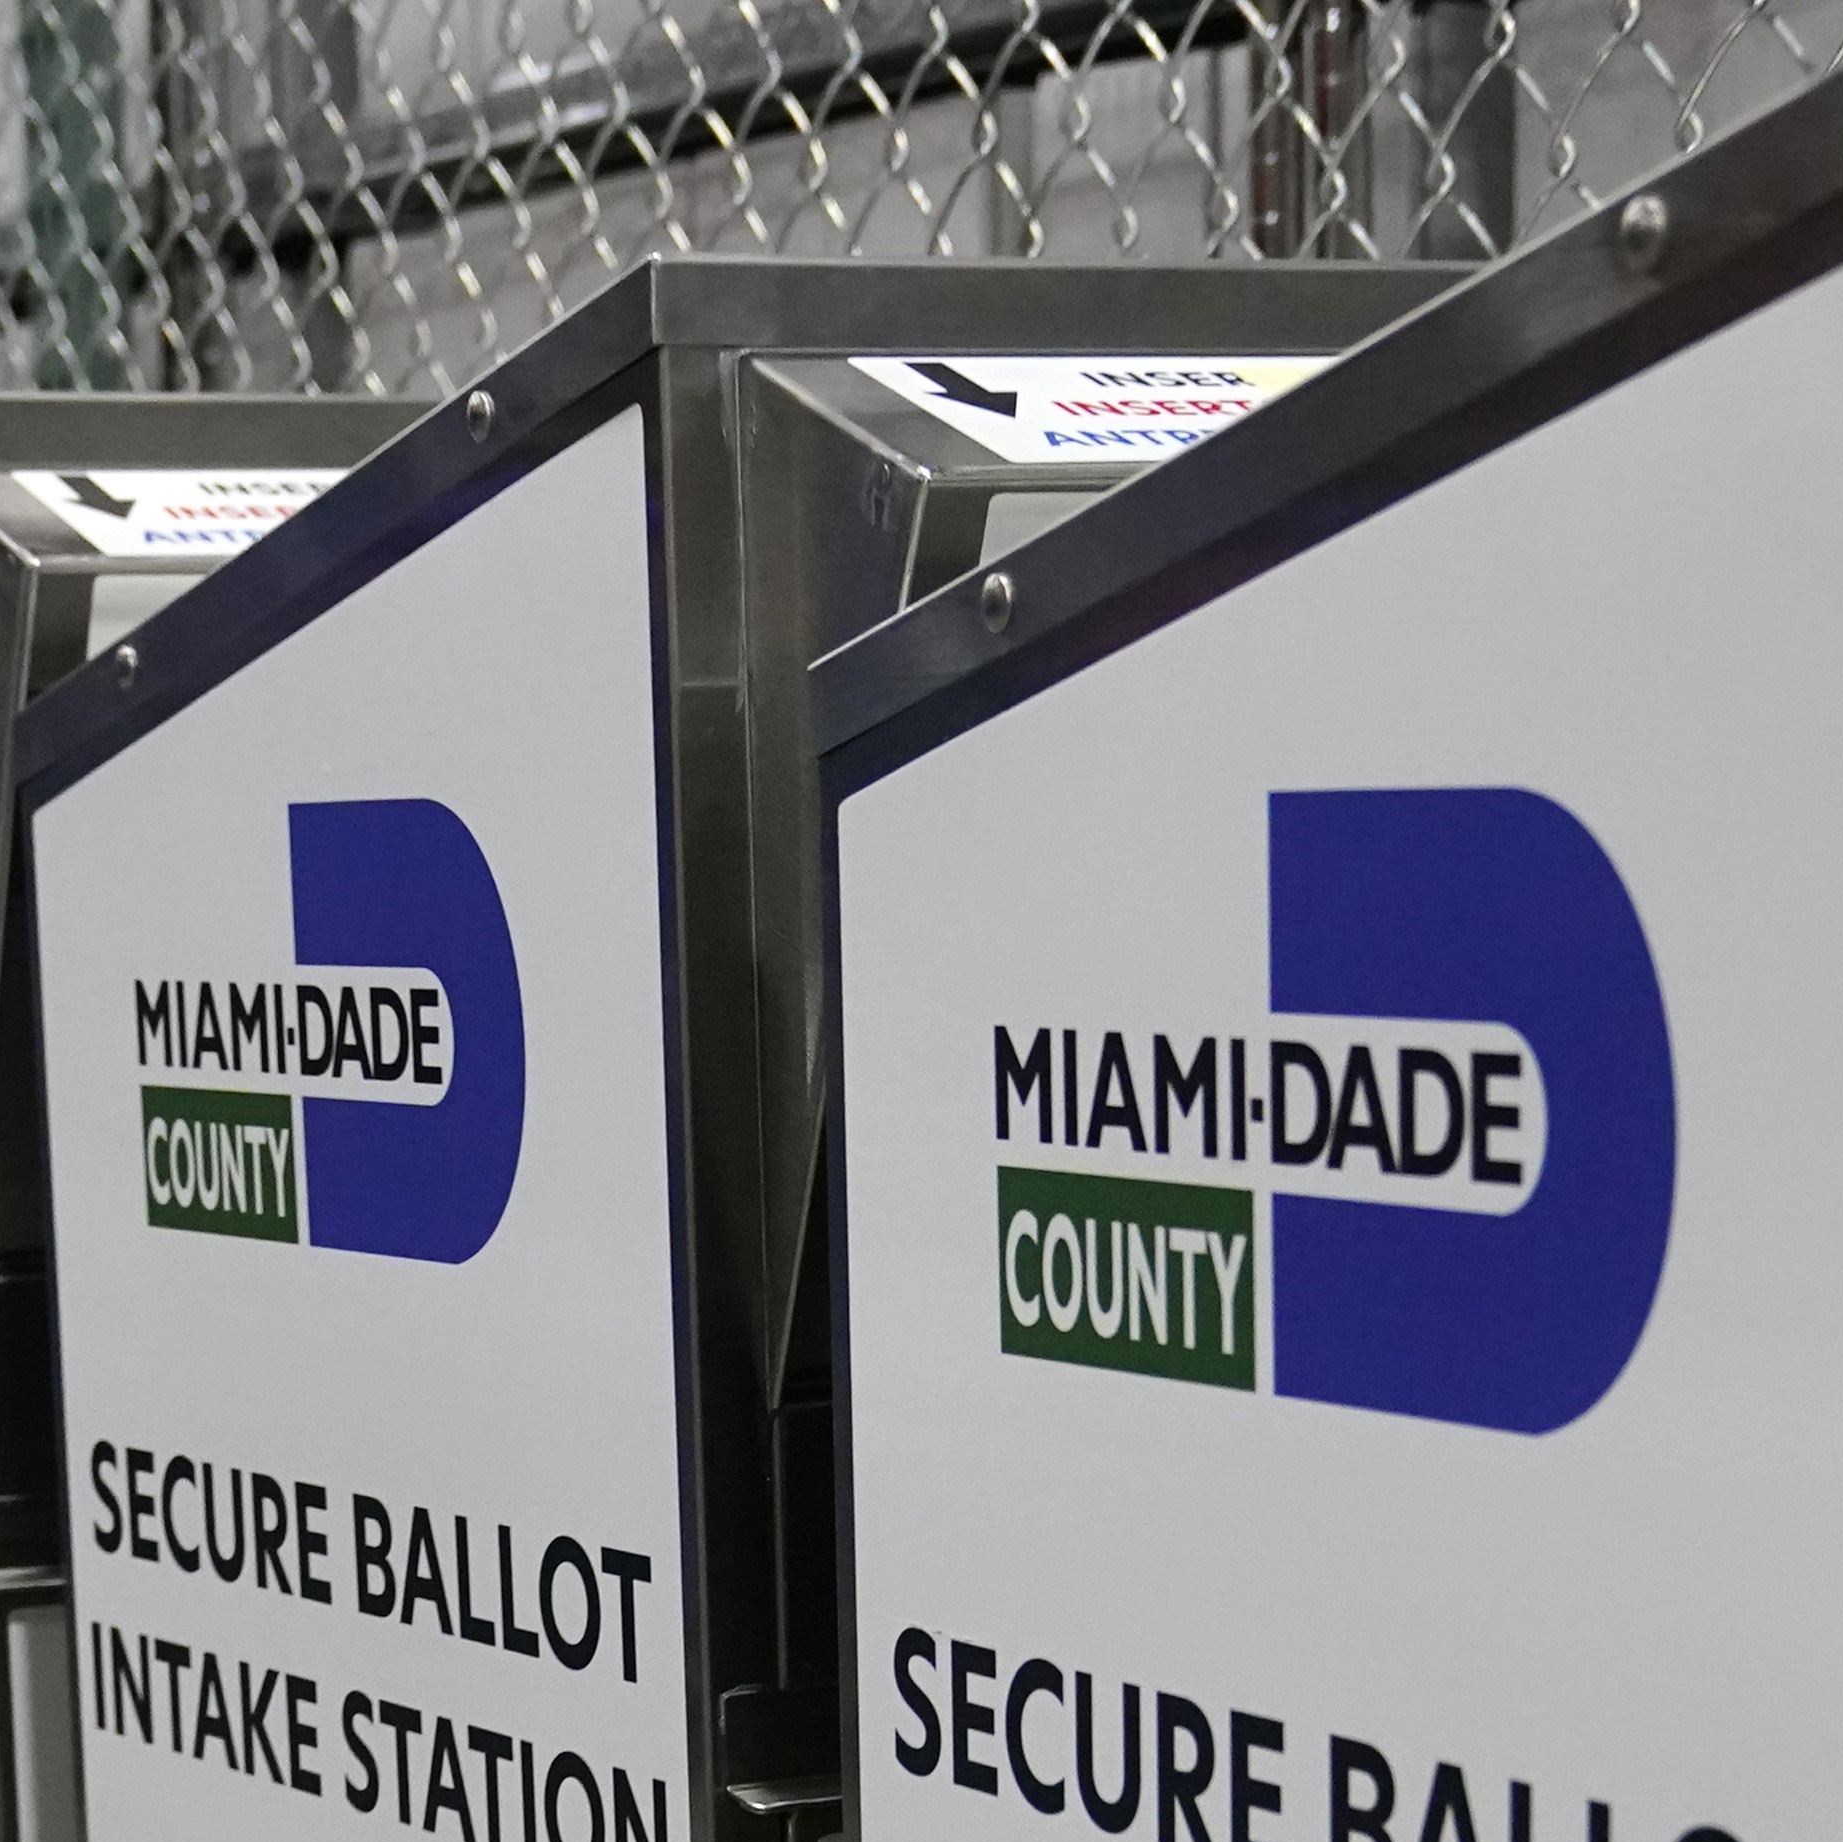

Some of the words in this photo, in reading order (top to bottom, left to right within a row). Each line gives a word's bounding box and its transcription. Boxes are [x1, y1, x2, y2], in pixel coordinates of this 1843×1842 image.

[1043, 430, 1215, 447] ANTR
[135, 980, 443, 1085] MIAMI-DADE
[994, 1023, 1523, 1186] MIAMI-DADE
[147, 1115, 289, 1217] COUNTY
[1005, 1208, 1247, 1354] COUNTY
[90, 1439, 333, 1605] SECURE
[353, 1492, 652, 1684] BALLOT
[91, 1621, 322, 1797] INTAKE
